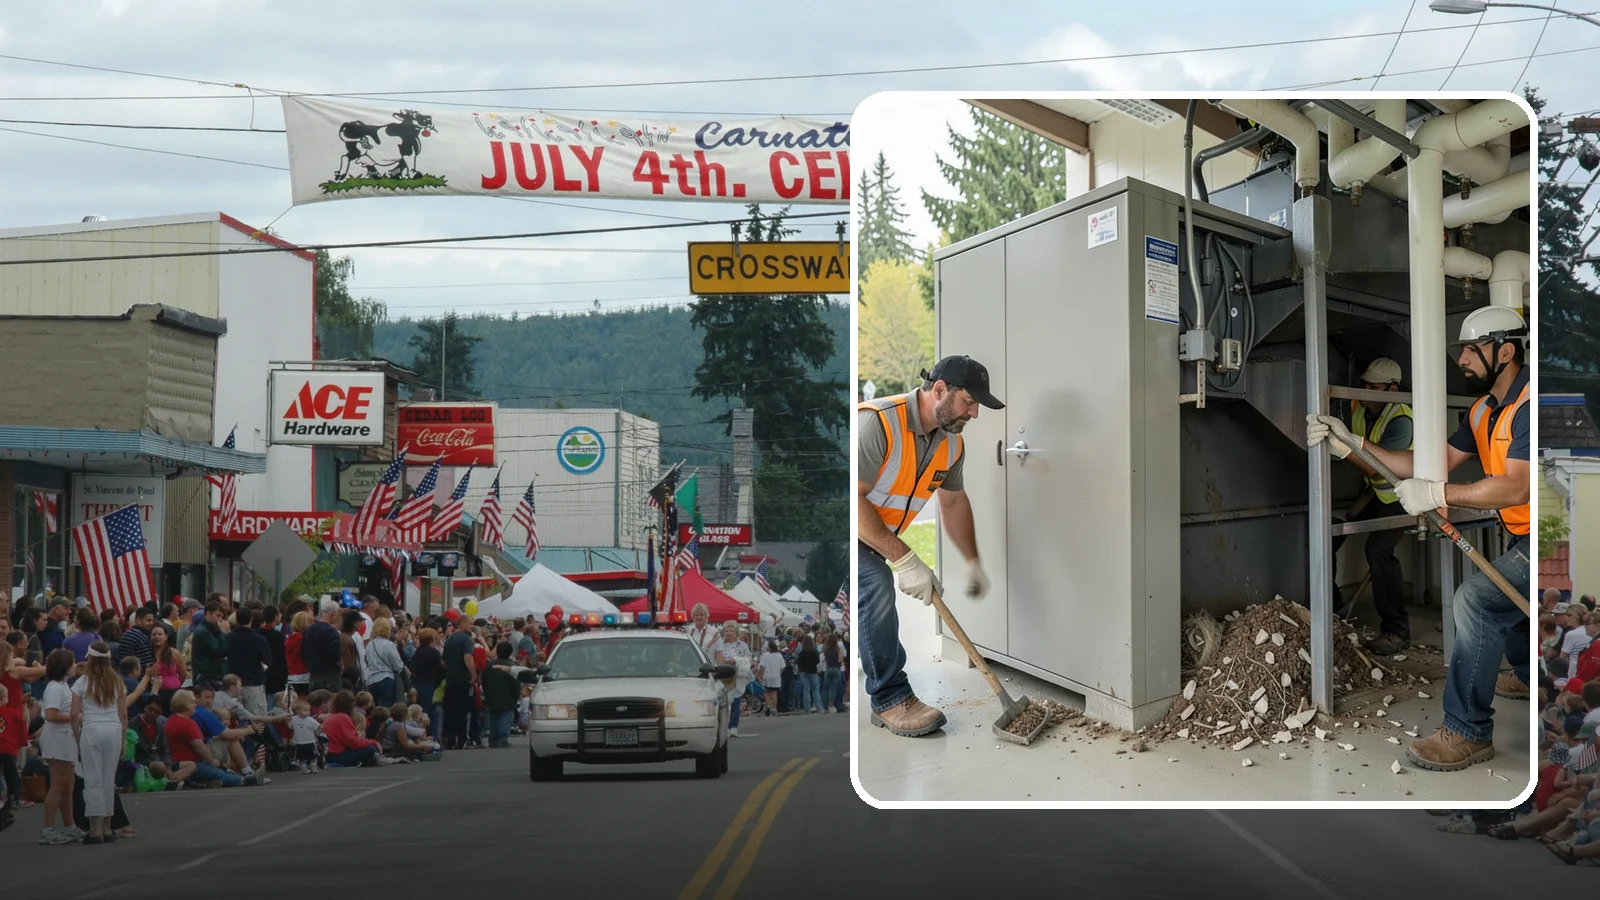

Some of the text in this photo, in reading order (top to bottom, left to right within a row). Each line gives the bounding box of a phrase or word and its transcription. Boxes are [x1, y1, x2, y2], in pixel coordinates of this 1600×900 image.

[695, 121, 850, 150] Carnat
[481, 141, 604, 192] JULY
[632, 150, 746, 198] 4th.
[697, 254, 850, 280] CROSSWA
[282, 380, 373, 420] ACE
[405, 408, 452, 422] CEDAR
[283, 421, 370, 436] Hardware
[416, 428, 477, 447] Coca-Cola
[96, 485, 125, 495] Vincent
[125, 486, 135, 495] de
[137, 486, 155, 495] Paul
[688, 526, 741, 535] CRNATION
[699, 535, 730, 543] GLASS
